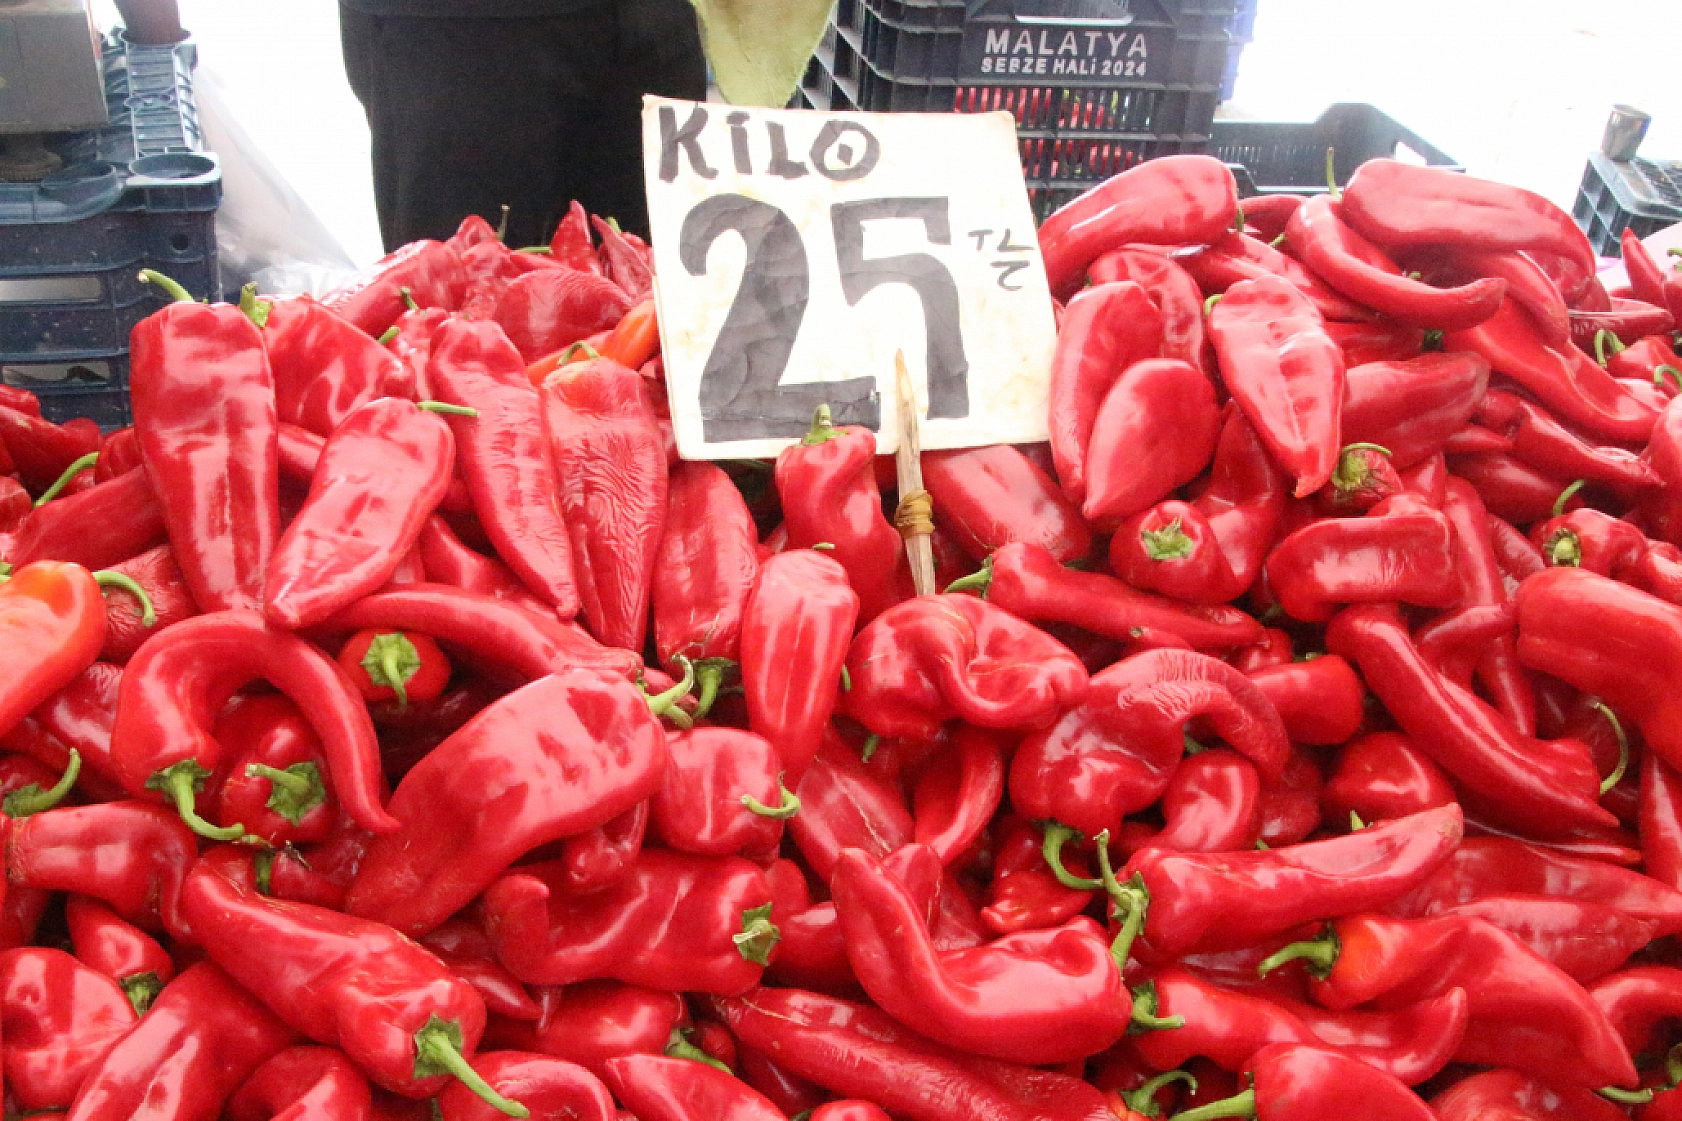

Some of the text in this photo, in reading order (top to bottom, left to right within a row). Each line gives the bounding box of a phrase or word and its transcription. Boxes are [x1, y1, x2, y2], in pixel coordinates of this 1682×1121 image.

[984, 28, 1147, 58] MALATYA
[981, 57, 1047, 75] SEBZE
[1101, 59, 1147, 76] 2024
[679, 193, 1035, 443] 25 TL
